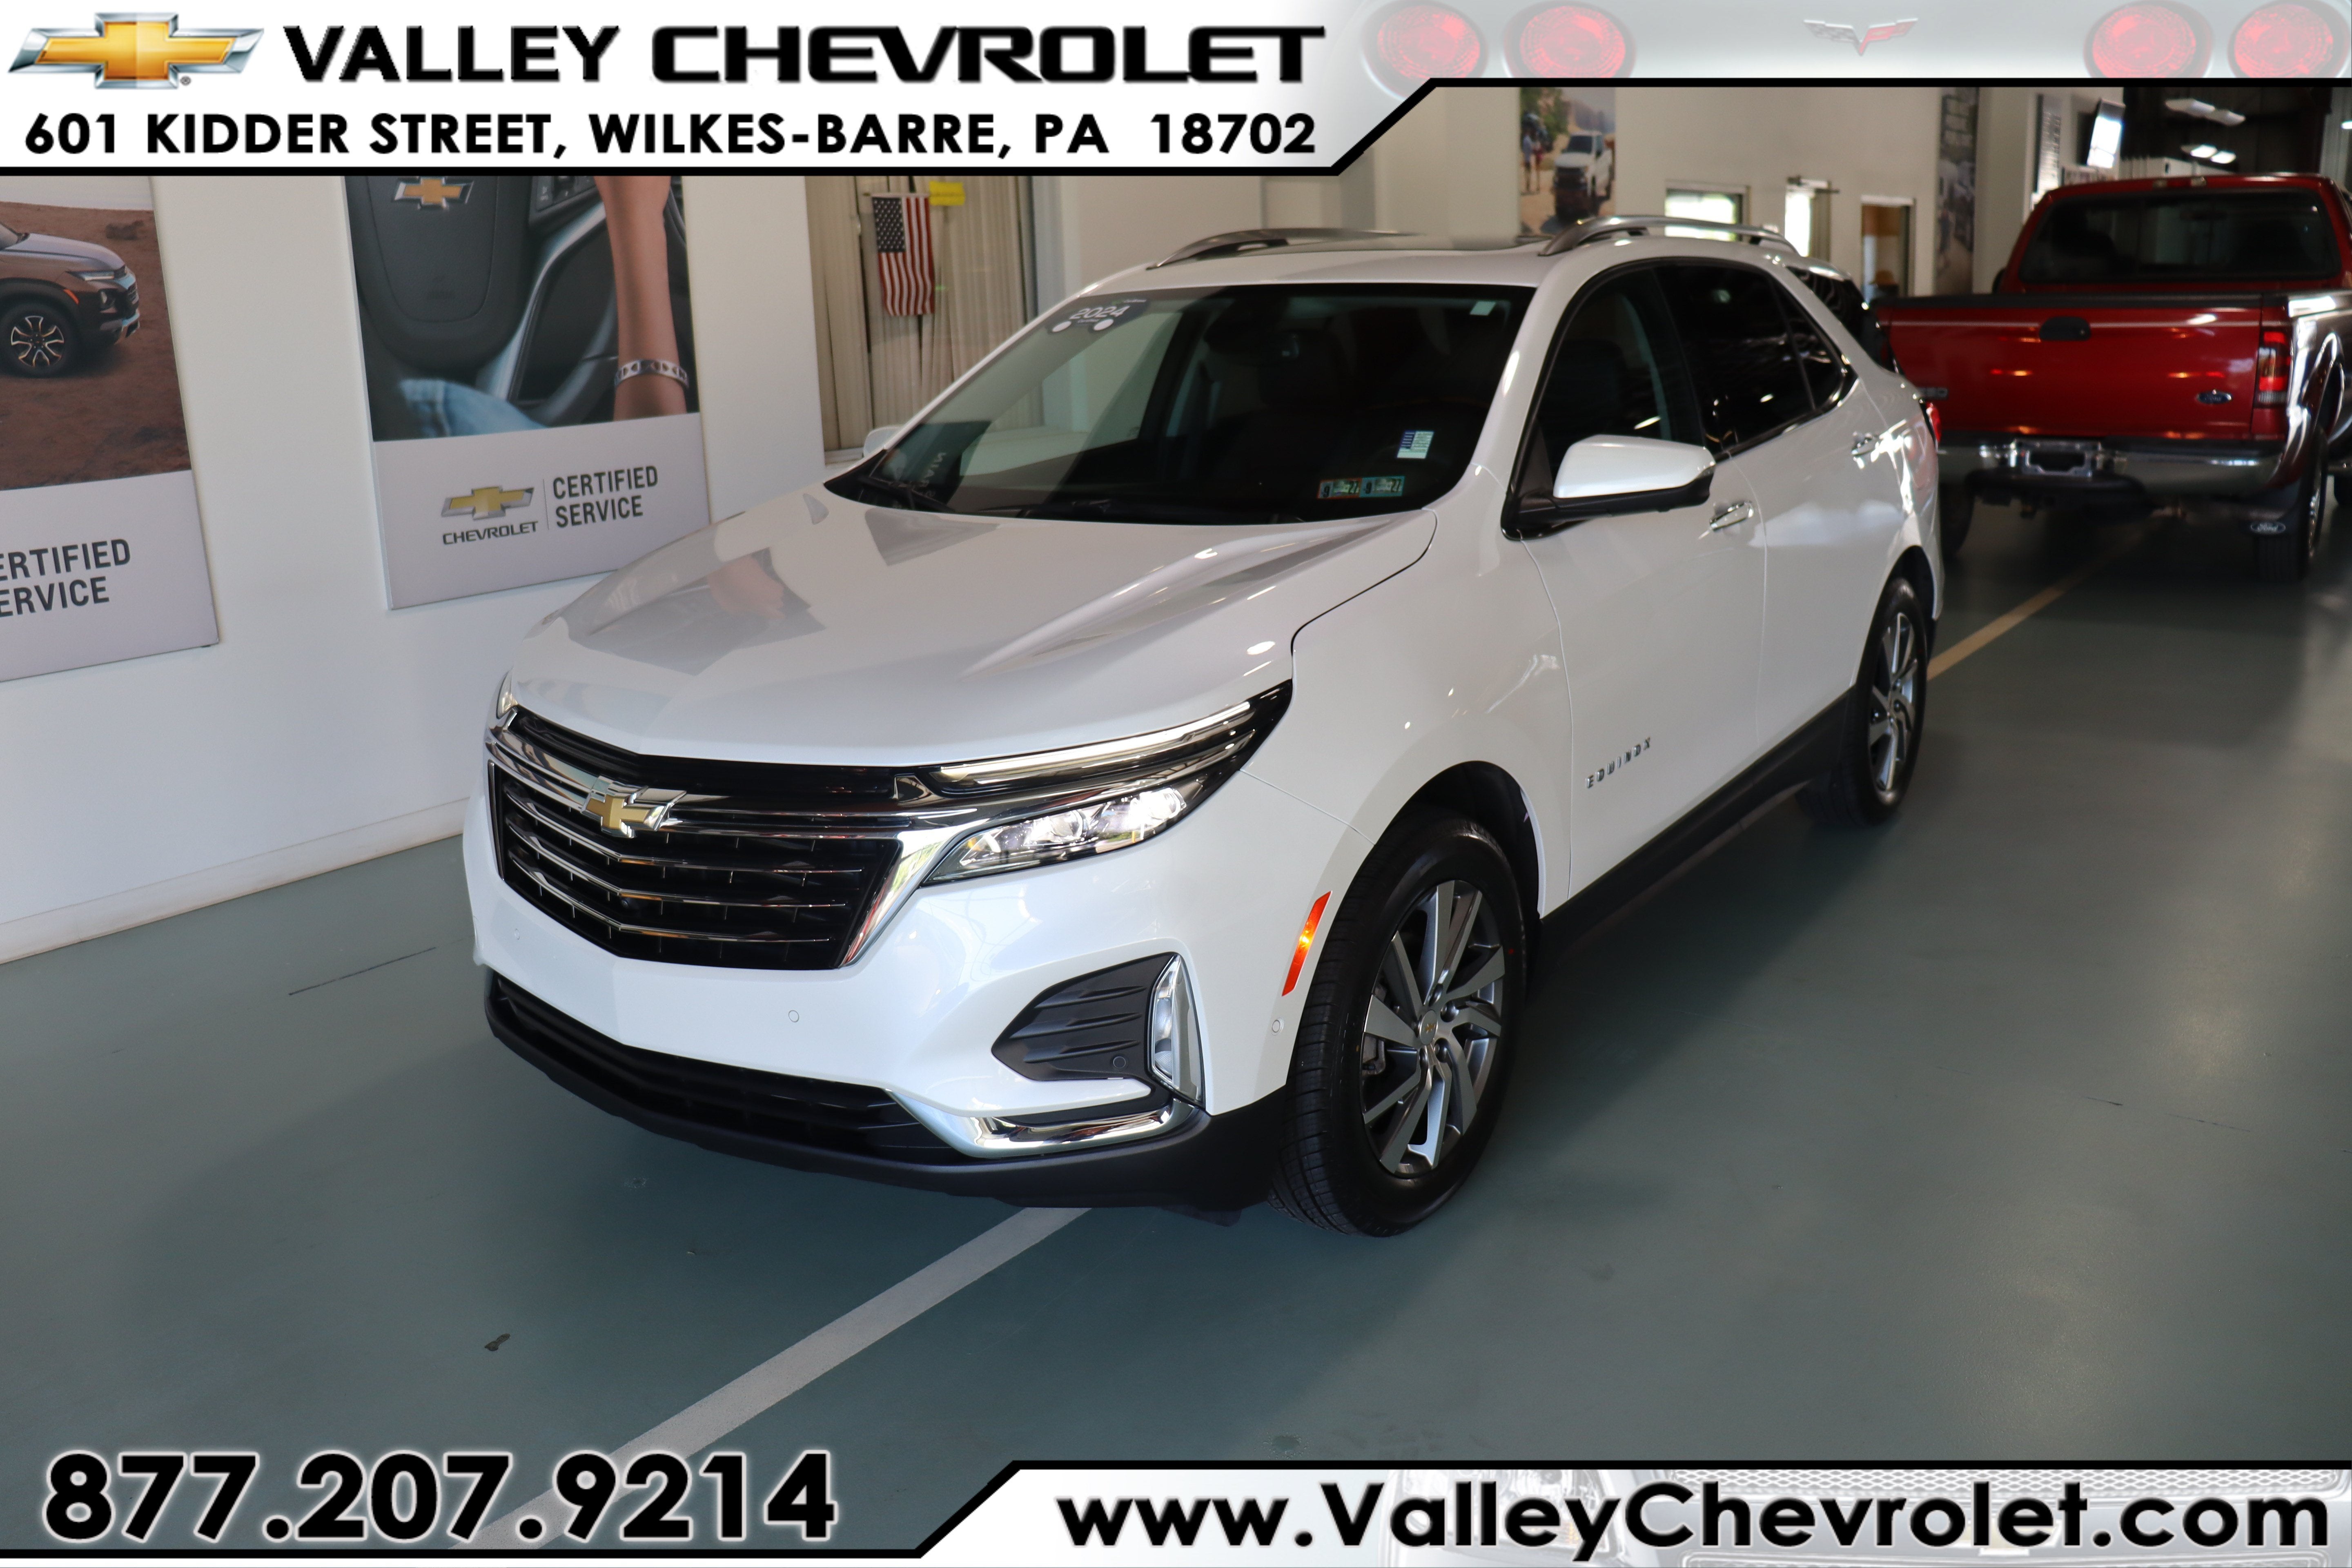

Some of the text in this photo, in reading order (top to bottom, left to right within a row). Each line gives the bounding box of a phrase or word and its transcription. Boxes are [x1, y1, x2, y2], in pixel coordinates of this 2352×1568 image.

[1069, 306, 1130, 320] 2024
[553, 466, 658, 499] CERTIFIED
[555, 495, 644, 528] SERVICE
[443, 521, 538, 545] CHEVROLET
